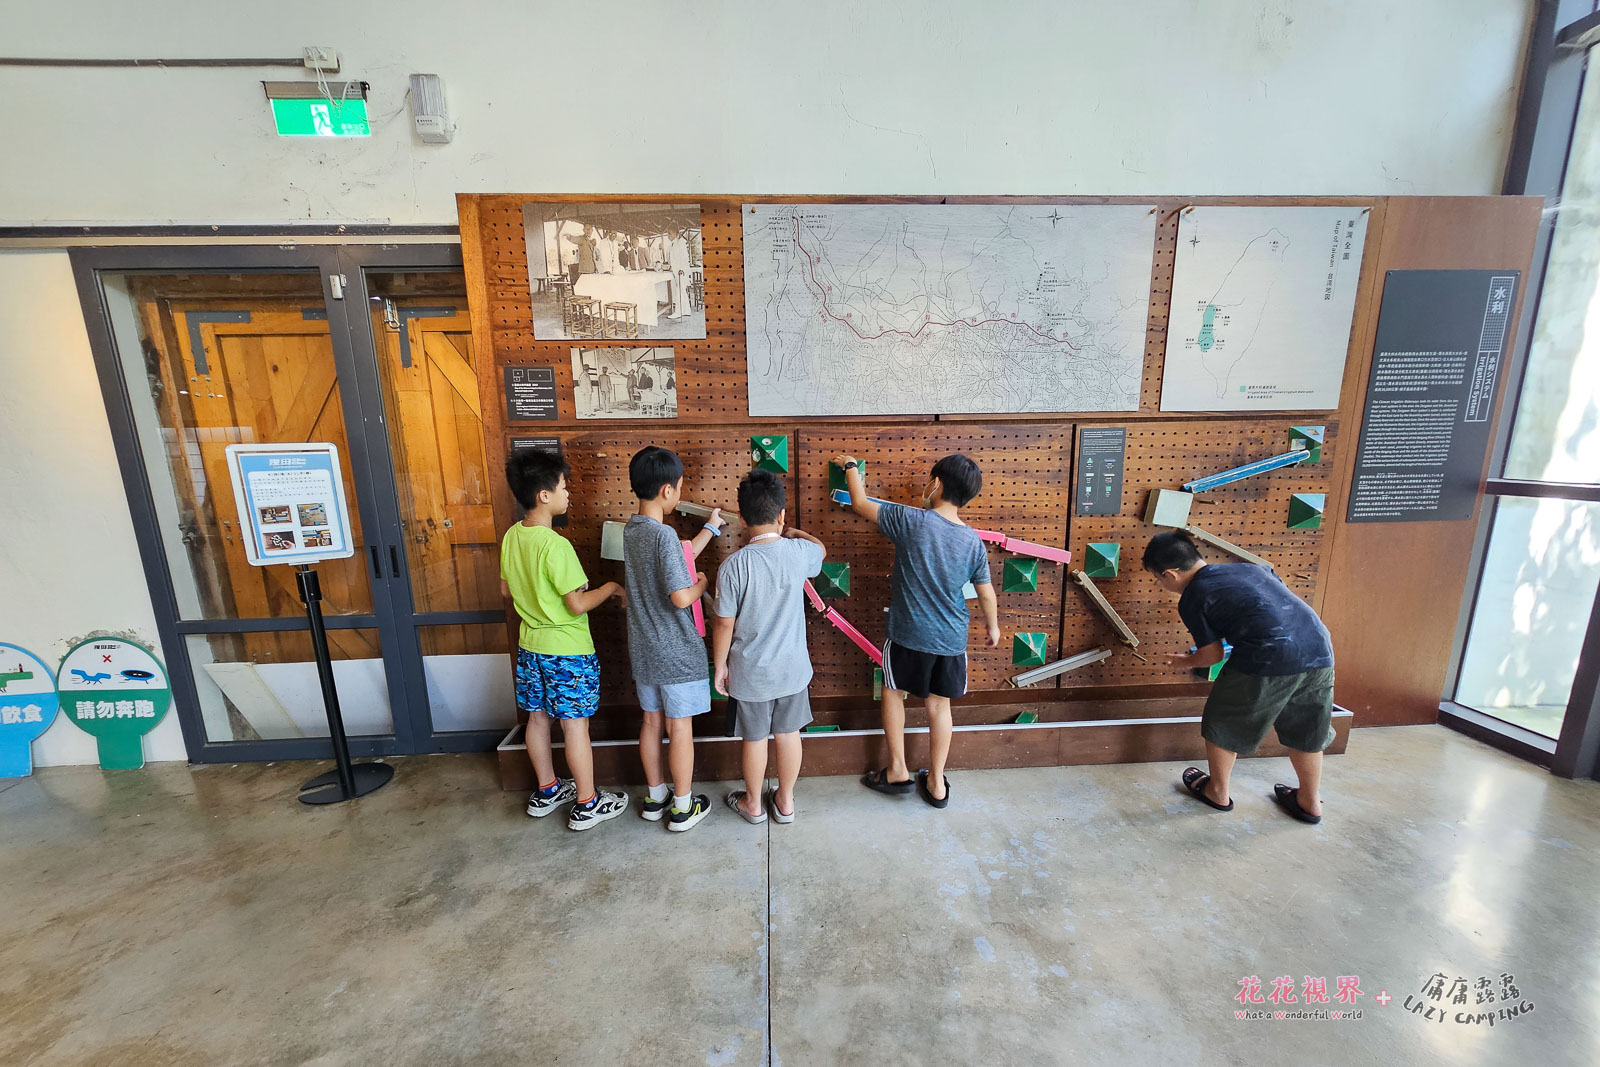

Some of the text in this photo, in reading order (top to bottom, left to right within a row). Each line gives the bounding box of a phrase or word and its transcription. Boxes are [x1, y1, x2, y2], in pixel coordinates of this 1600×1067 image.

[1333, 235, 1338, 243] of
[1329, 244, 1338, 267] Taiwan
[1491, 286, 1507, 314] 水利
[1469, 356, 1487, 416] Irrigation System
[0, 703, 43, 725] 飲食
[75, 699, 155, 720] 請勿奔跑
